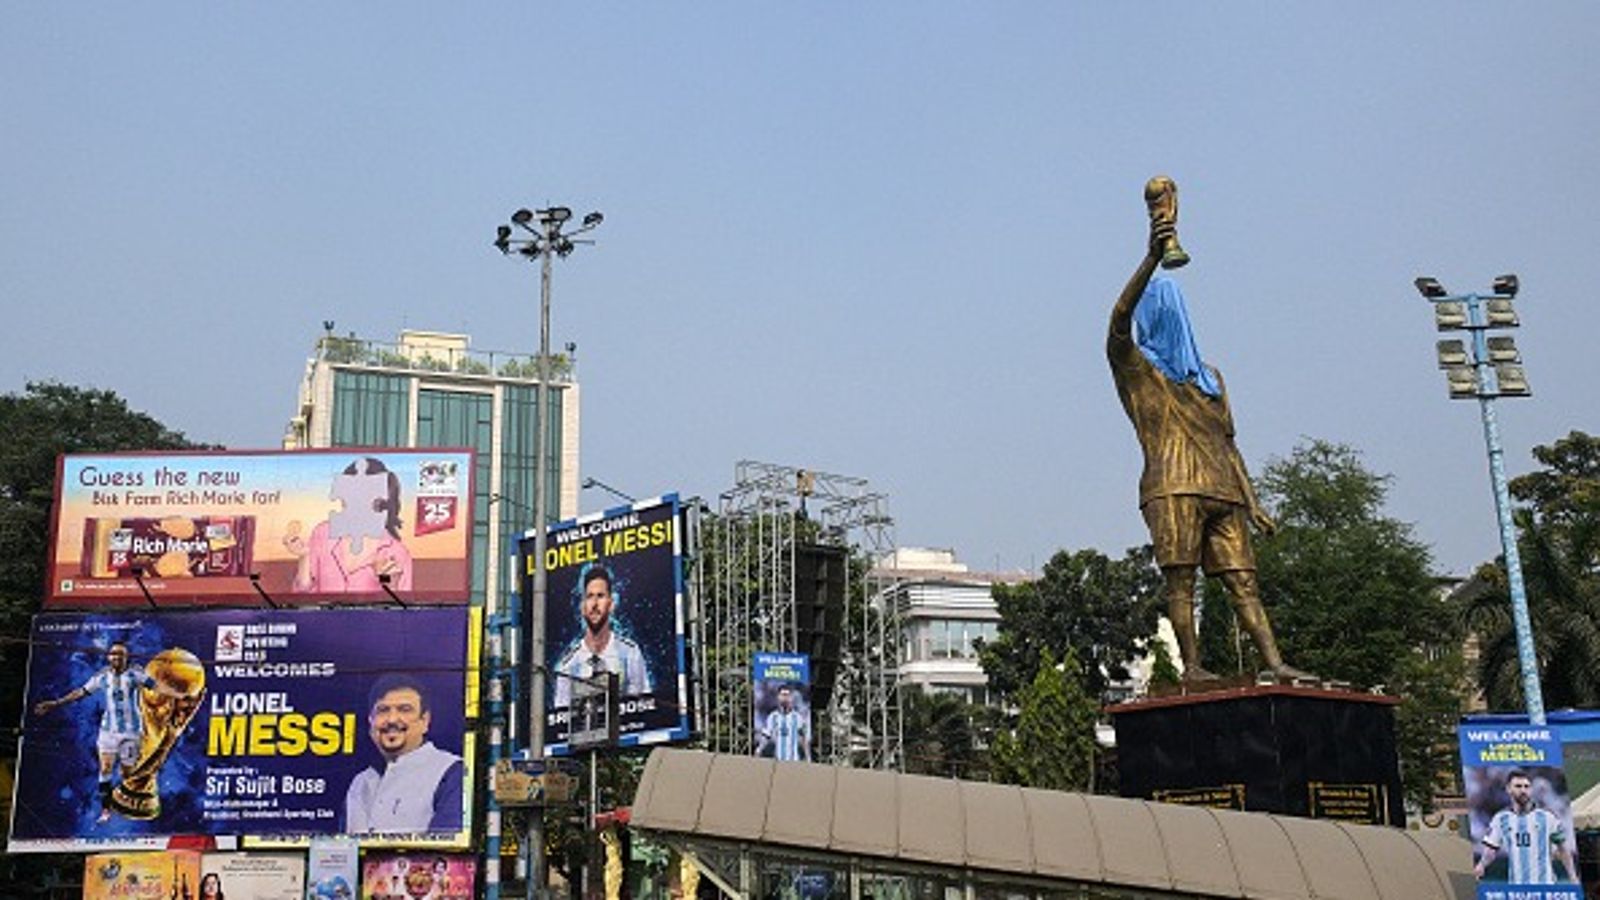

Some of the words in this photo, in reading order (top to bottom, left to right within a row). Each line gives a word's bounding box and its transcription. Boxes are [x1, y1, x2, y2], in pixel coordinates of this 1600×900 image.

[80, 466, 143, 486] Guess
[155, 466, 188, 486] the
[197, 471, 240, 486] new
[166, 490, 199, 505] Rich
[424, 502, 452, 521] 25
[556, 513, 640, 544] WELCOME
[133, 537, 165, 553] Rich
[167, 535, 208, 553] Marie
[526, 538, 599, 576] LONEL
[604, 519, 672, 557] MESSI
[214, 663, 336, 678] WELCOMES
[211, 693, 294, 714] LIONEL
[207, 713, 356, 756] MESSI
[1467, 730, 1551, 741] WELCOME
[206, 776, 230, 796] Sri
[236, 776, 276, 798] Sujit
[282, 776, 326, 794] Bose
[1516, 833, 1531, 848] 10
